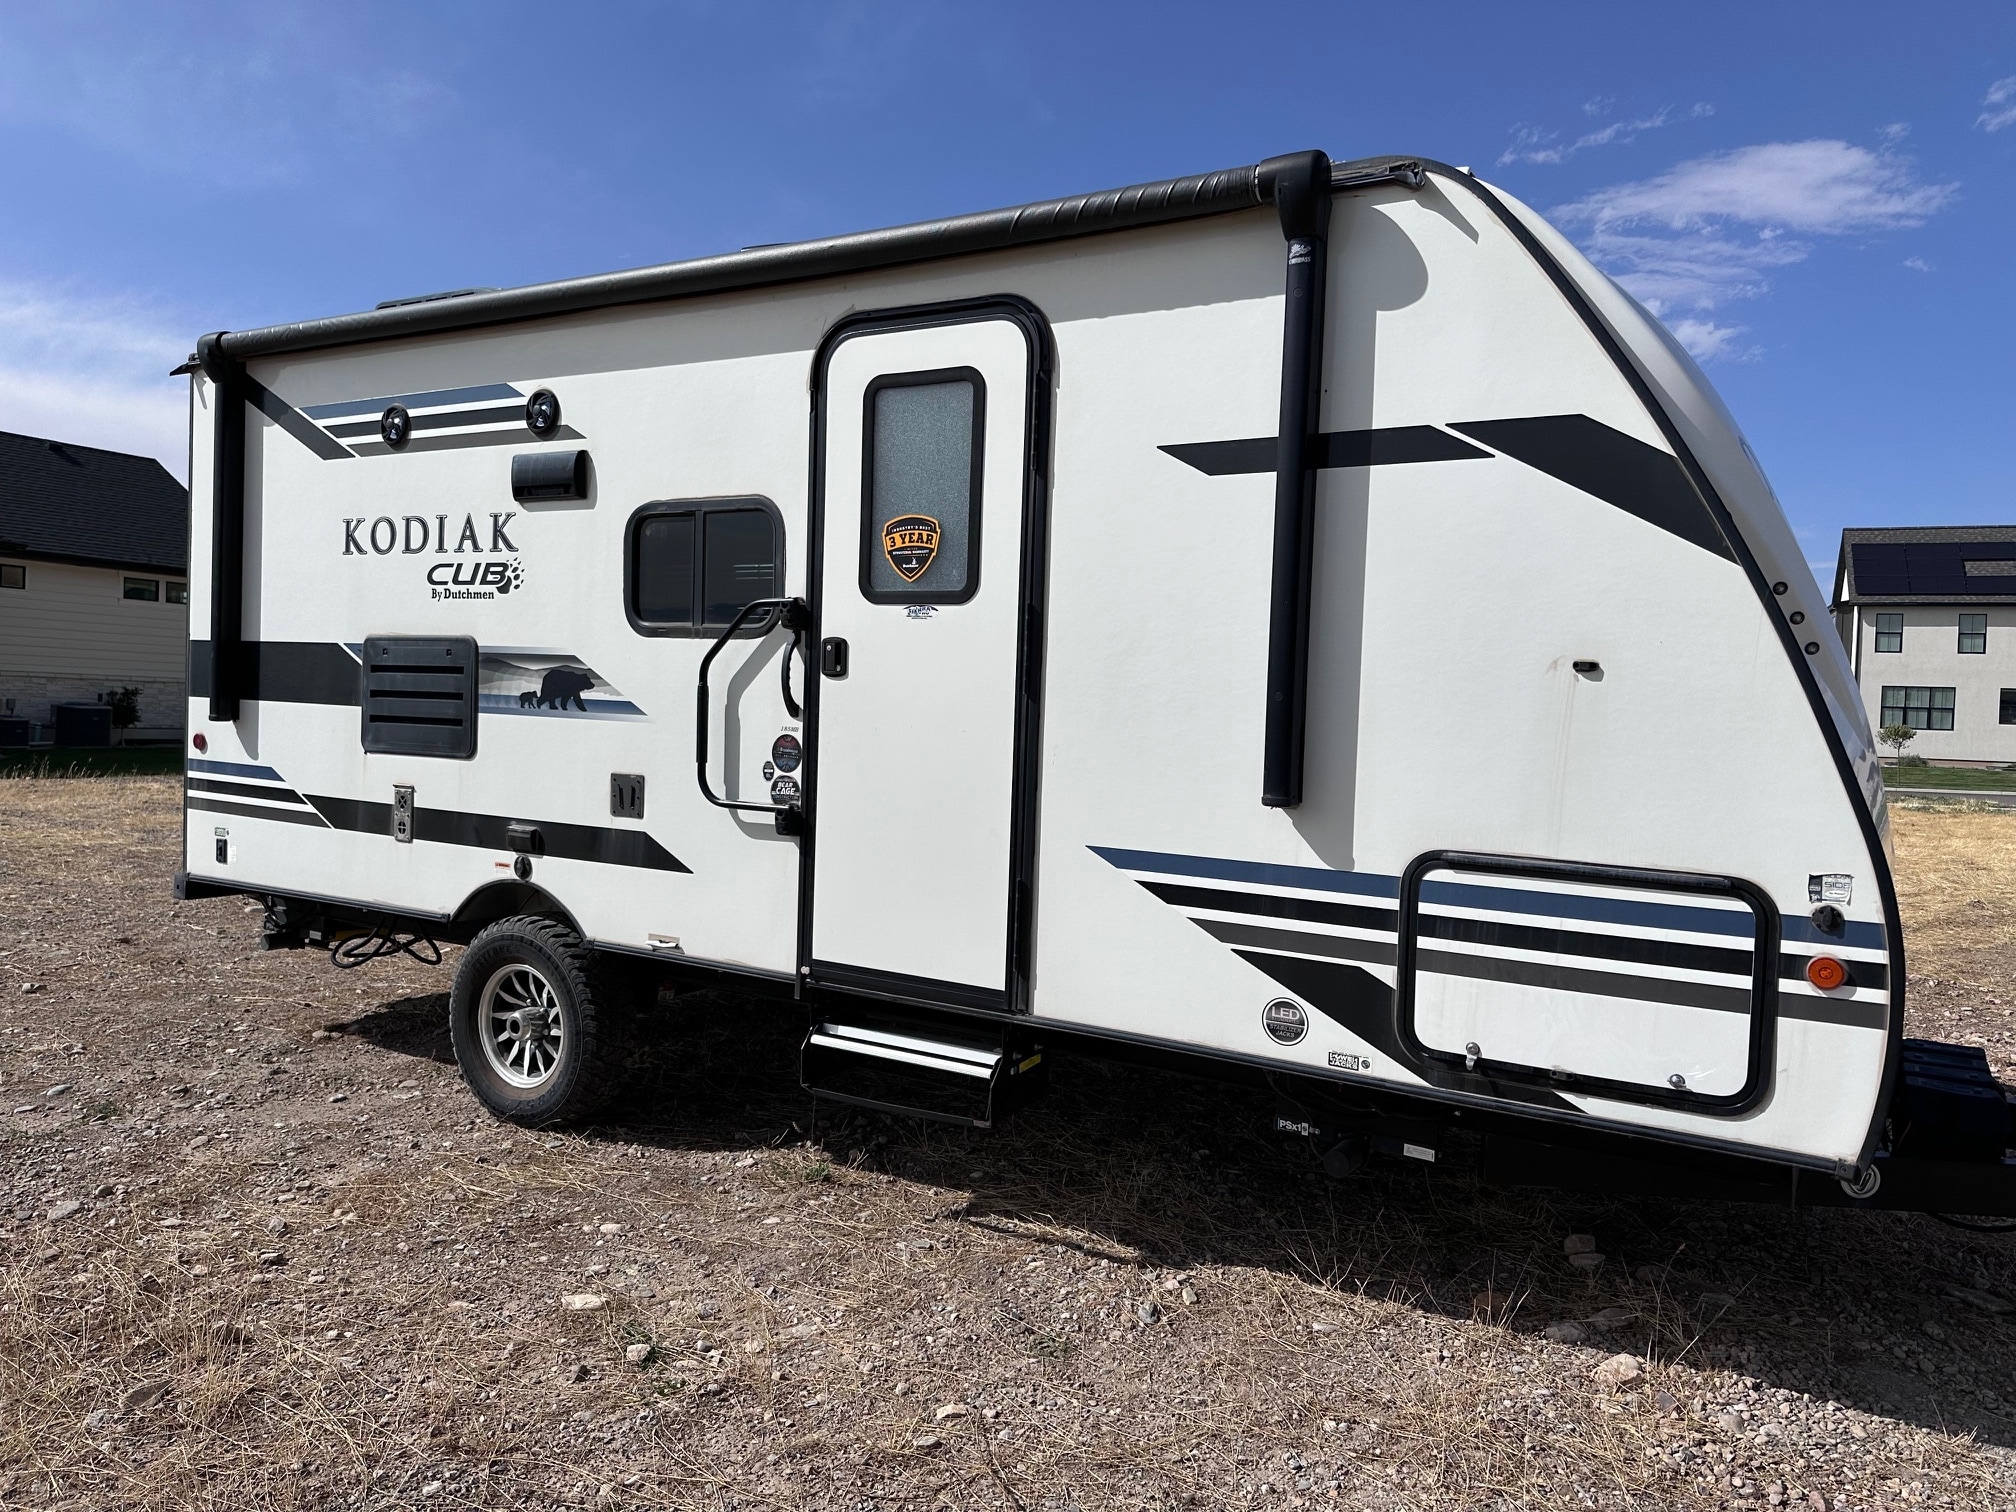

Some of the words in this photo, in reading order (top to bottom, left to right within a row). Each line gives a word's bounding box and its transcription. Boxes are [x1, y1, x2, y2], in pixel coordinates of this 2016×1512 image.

[342, 511, 519, 555] KODIAK
[888, 536, 896, 548] 3
[899, 532, 934, 546] YEAR
[426, 561, 512, 586] CUB
[431, 588, 443, 602] By
[444, 587, 495, 600] Dutchmen
[775, 787, 796, 795] CAGE
[1271, 1006, 1300, 1020] LED
[1269, 1023, 1302, 1034] STABILIZER
[1275, 1030, 1295, 1038] JACKS
[1279, 1119, 1302, 1132] PSx1
